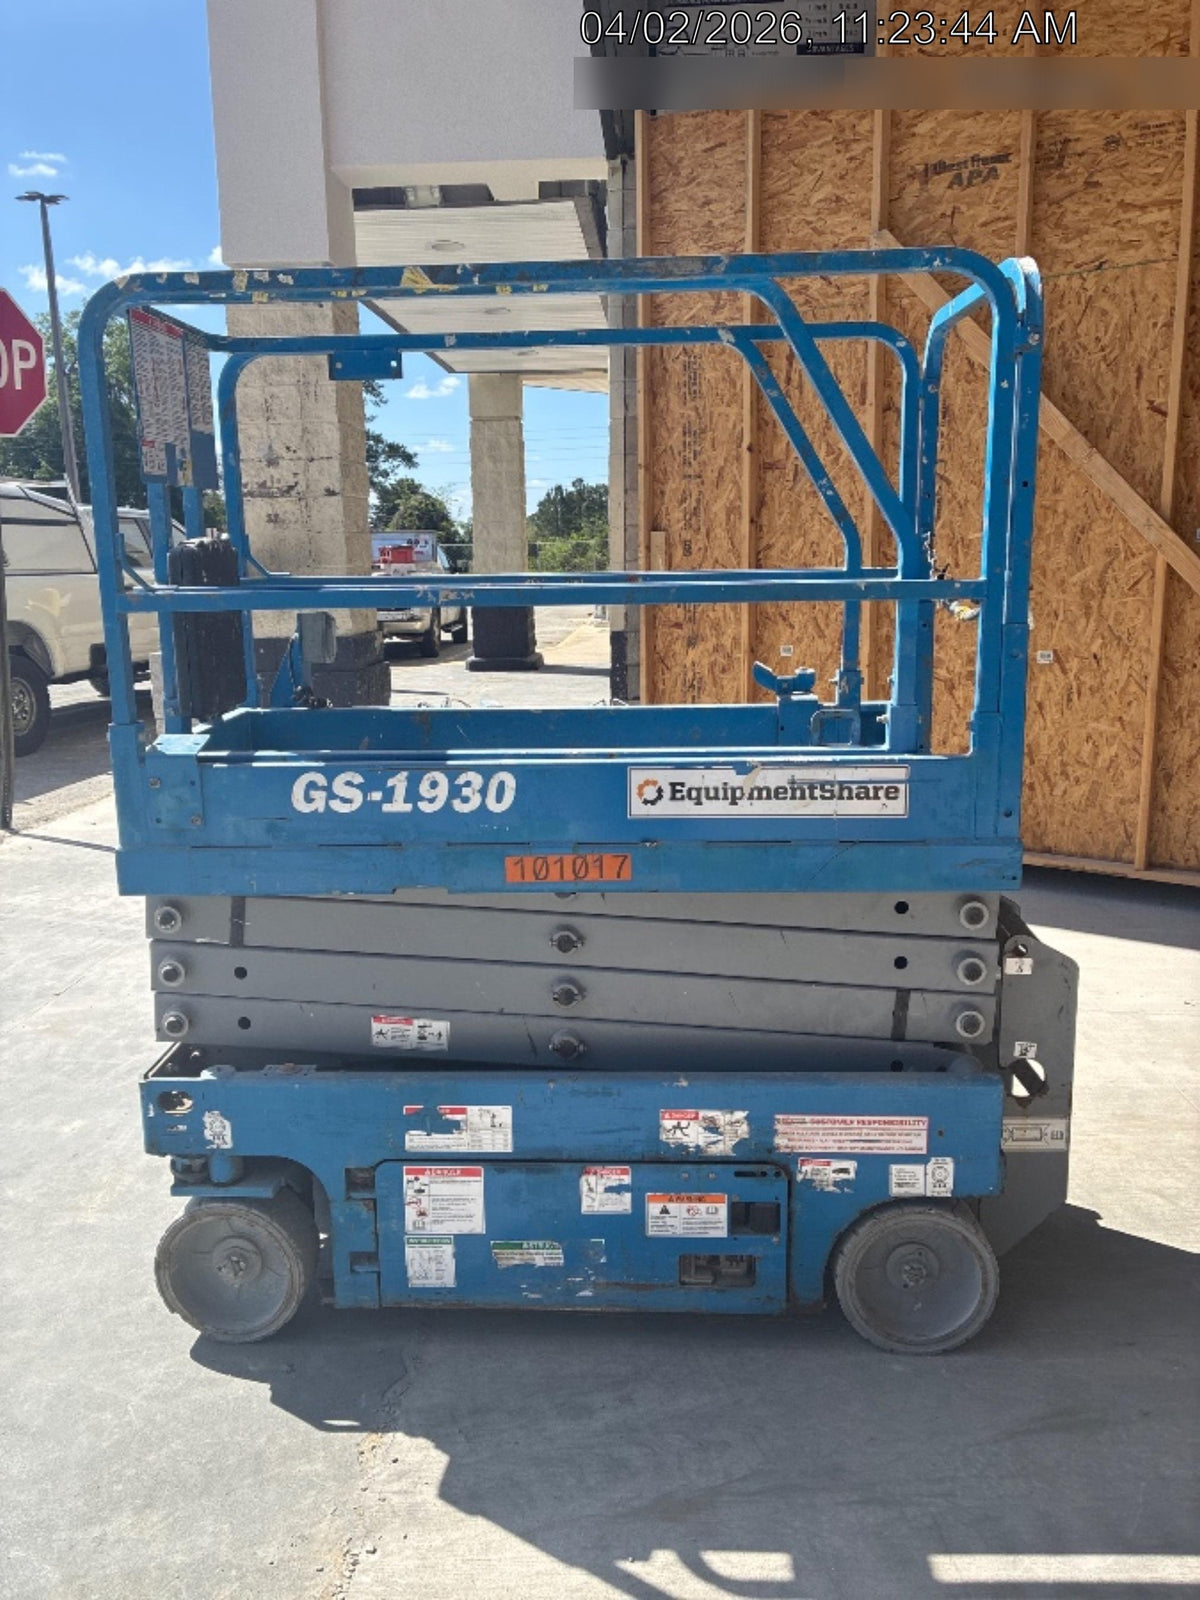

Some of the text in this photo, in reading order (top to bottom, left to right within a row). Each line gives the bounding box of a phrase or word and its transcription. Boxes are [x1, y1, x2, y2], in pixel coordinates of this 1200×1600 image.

[290, 770, 517, 814] GS-1930
[668, 780, 901, 806] EquipmentShare
[512, 854, 630, 882] 101017
